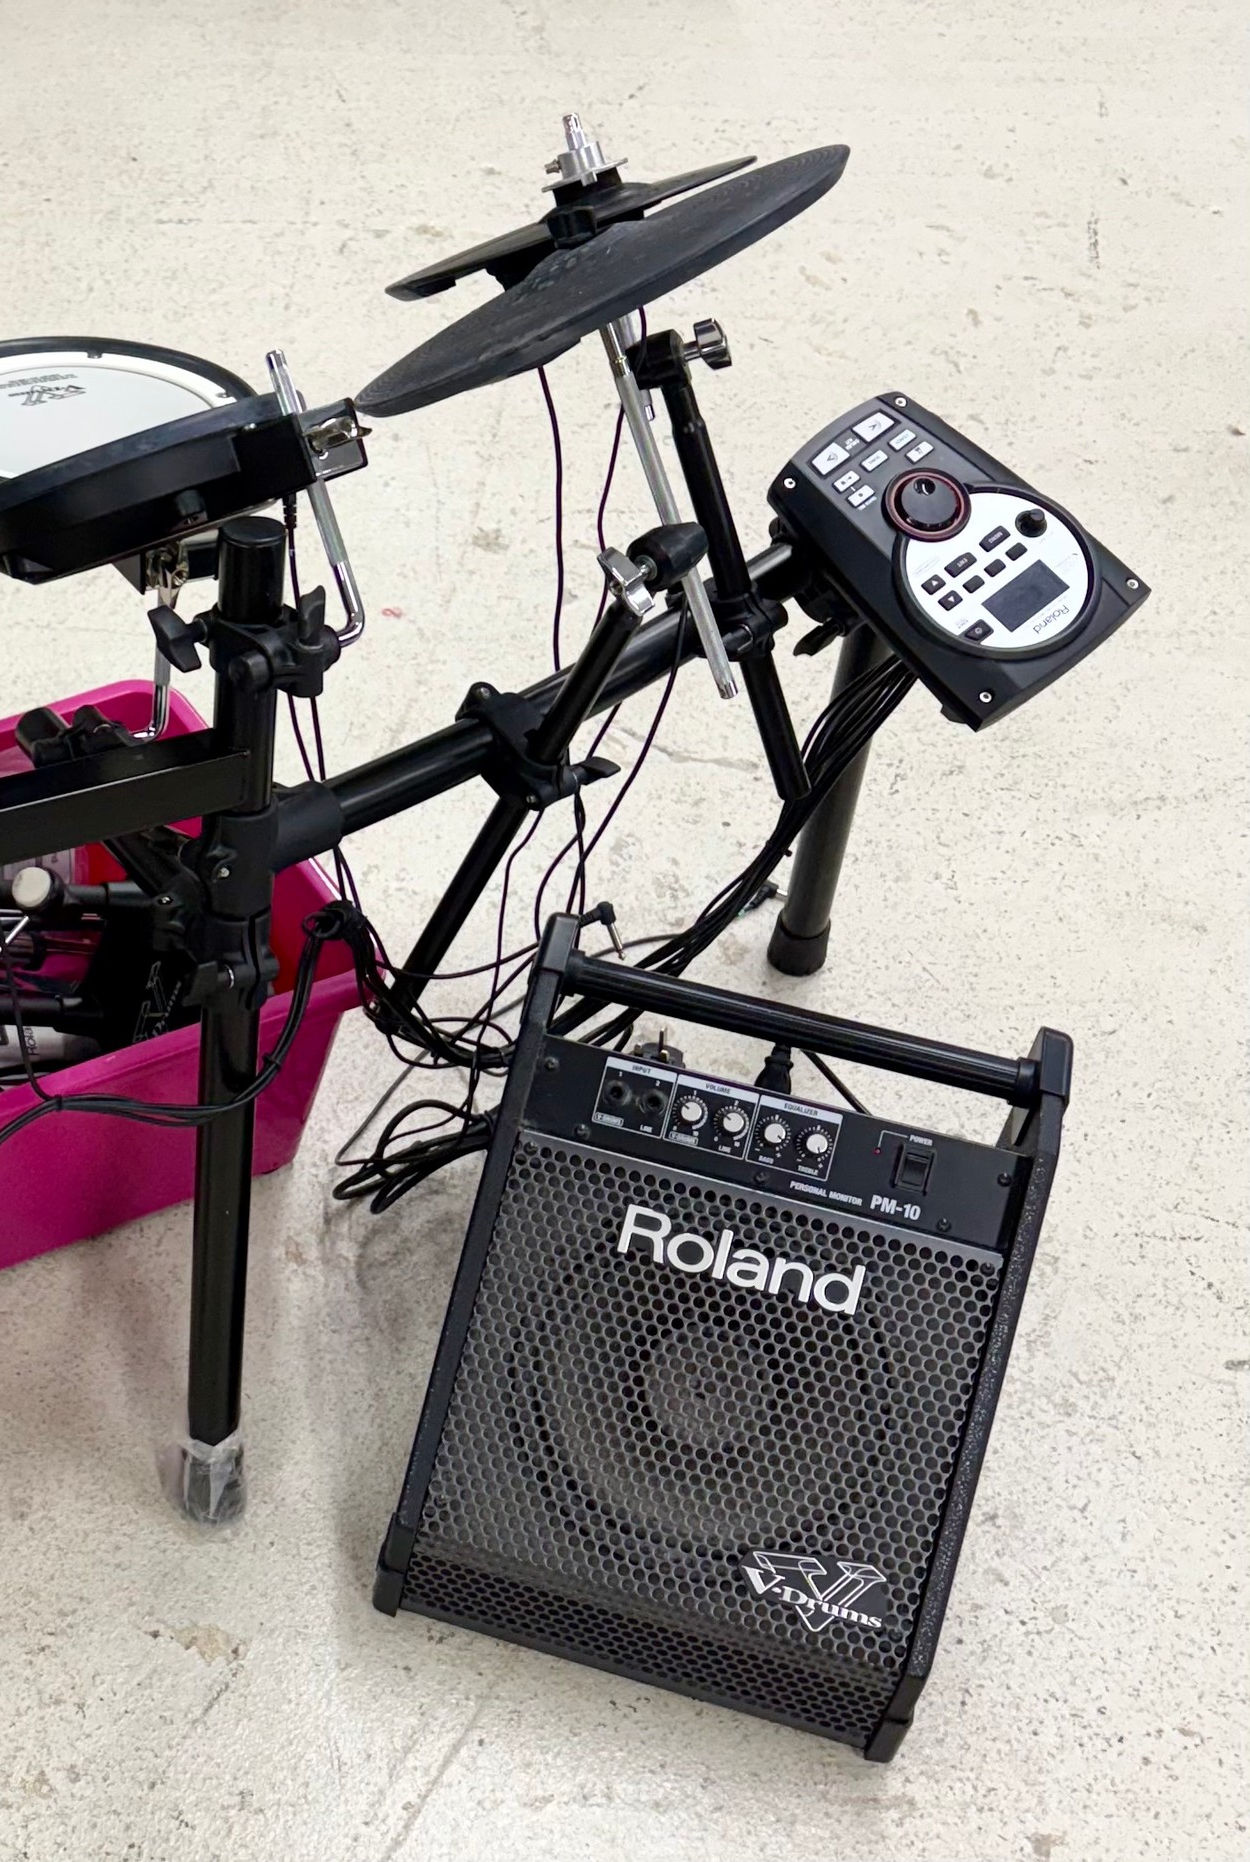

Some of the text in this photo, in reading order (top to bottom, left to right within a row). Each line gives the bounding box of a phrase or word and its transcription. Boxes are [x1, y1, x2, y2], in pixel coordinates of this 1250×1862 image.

[1033, 605, 1070, 634] Roland
[25, 1027, 39, 1056] Rola
[631, 1064, 652, 1074] INPUT
[705, 1082, 732, 1095] VOLUME
[783, 1102, 819, 1117] EQUALIZER
[909, 1134, 933, 1146] POWER
[790, 1180, 921, 1221] PERSONAL MONITOR PM-10
[617, 1203, 866, 1316] Roland
